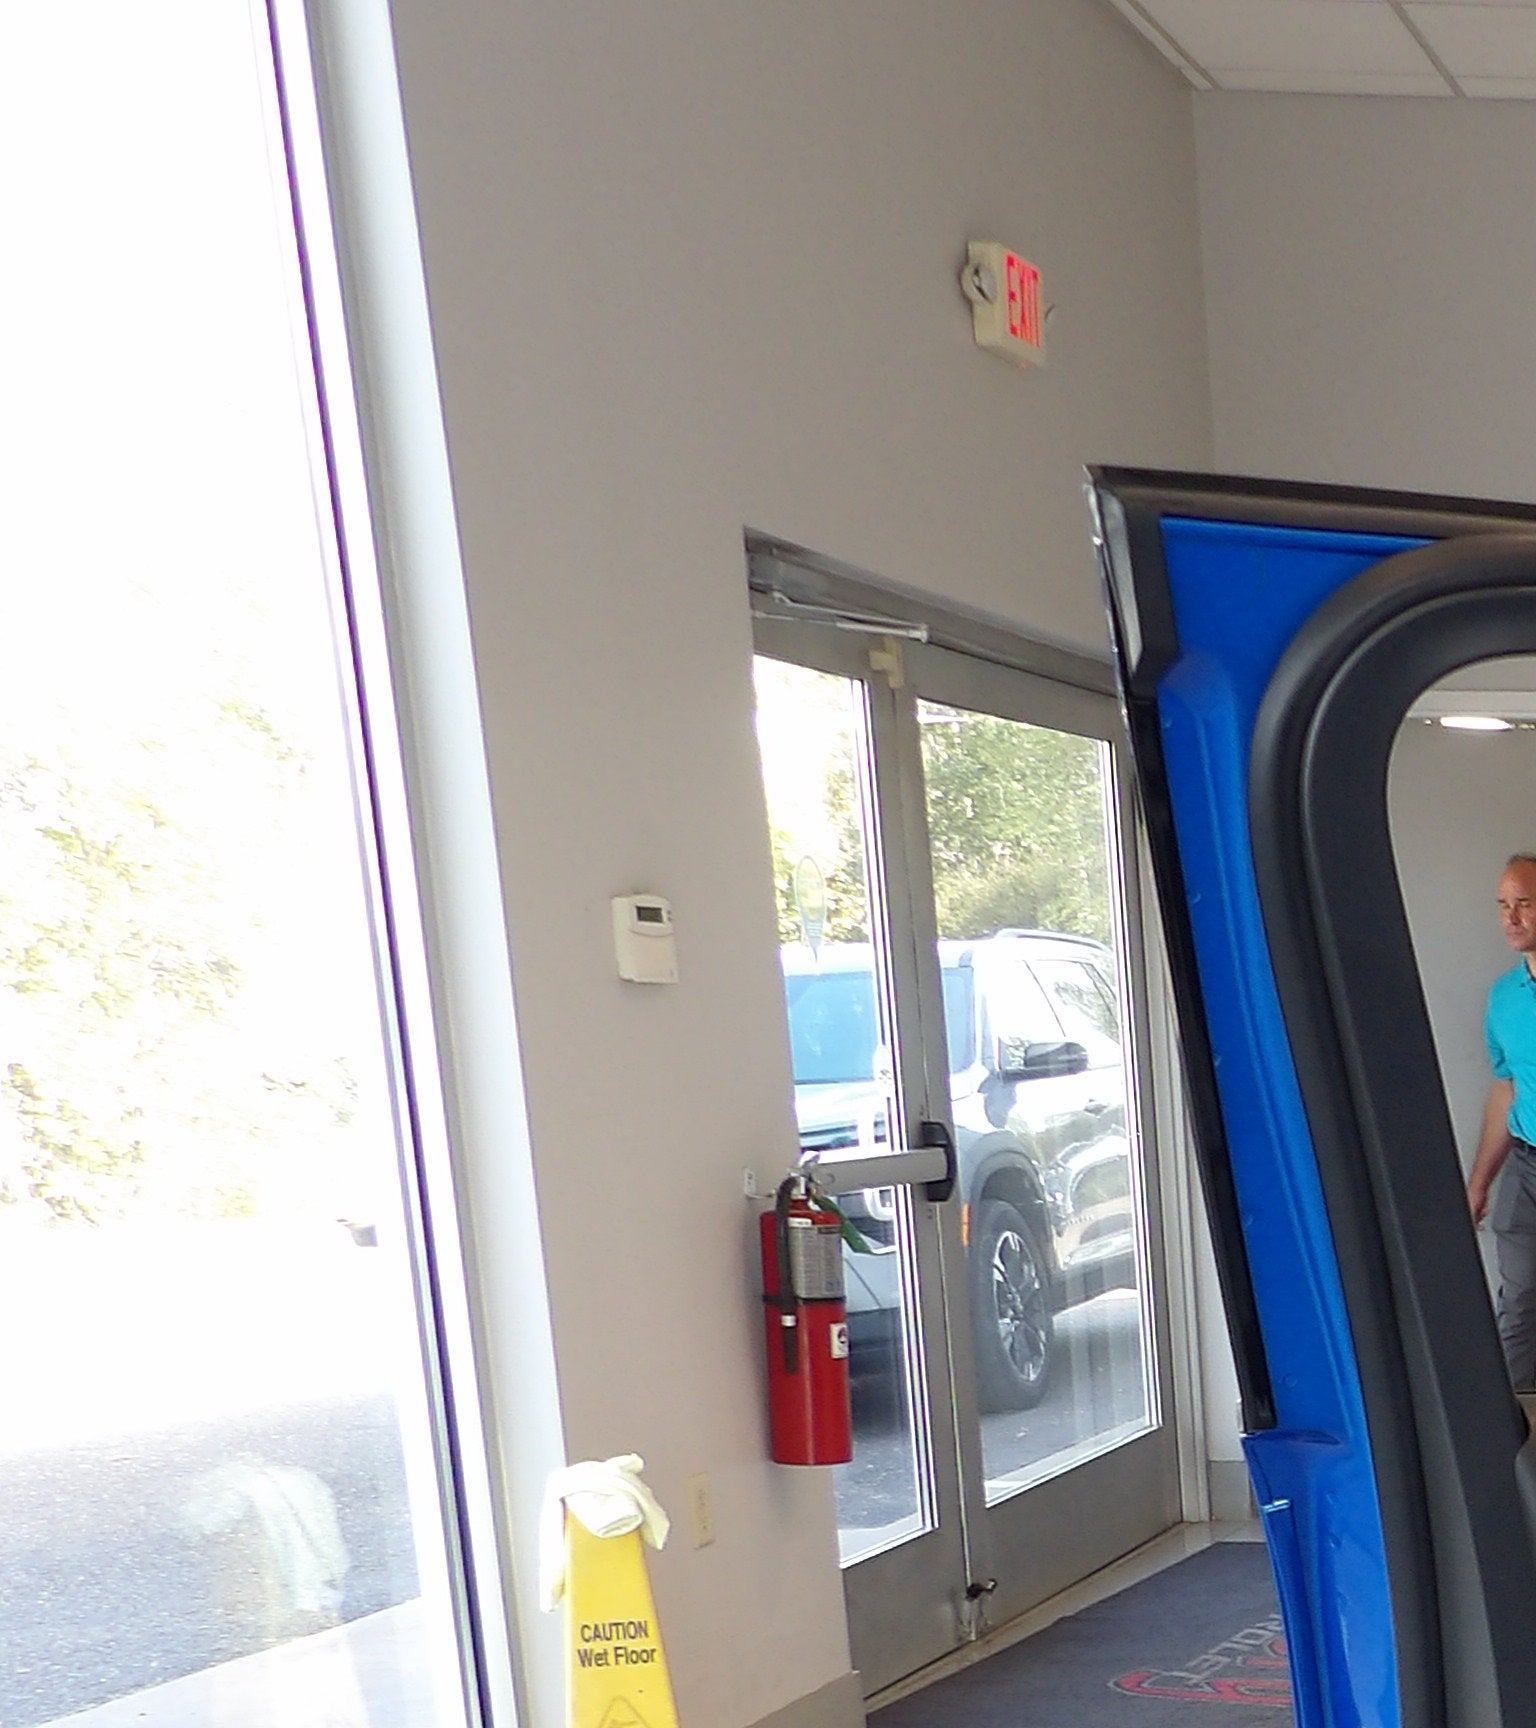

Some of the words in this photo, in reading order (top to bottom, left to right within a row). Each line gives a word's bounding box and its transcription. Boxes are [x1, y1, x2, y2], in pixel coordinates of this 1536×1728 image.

[1005, 253, 1041, 348] EXIT
[580, 1619, 650, 1643] CAUTION
[577, 1647, 611, 1668] Wet
[613, 1645, 657, 1666] Floor
